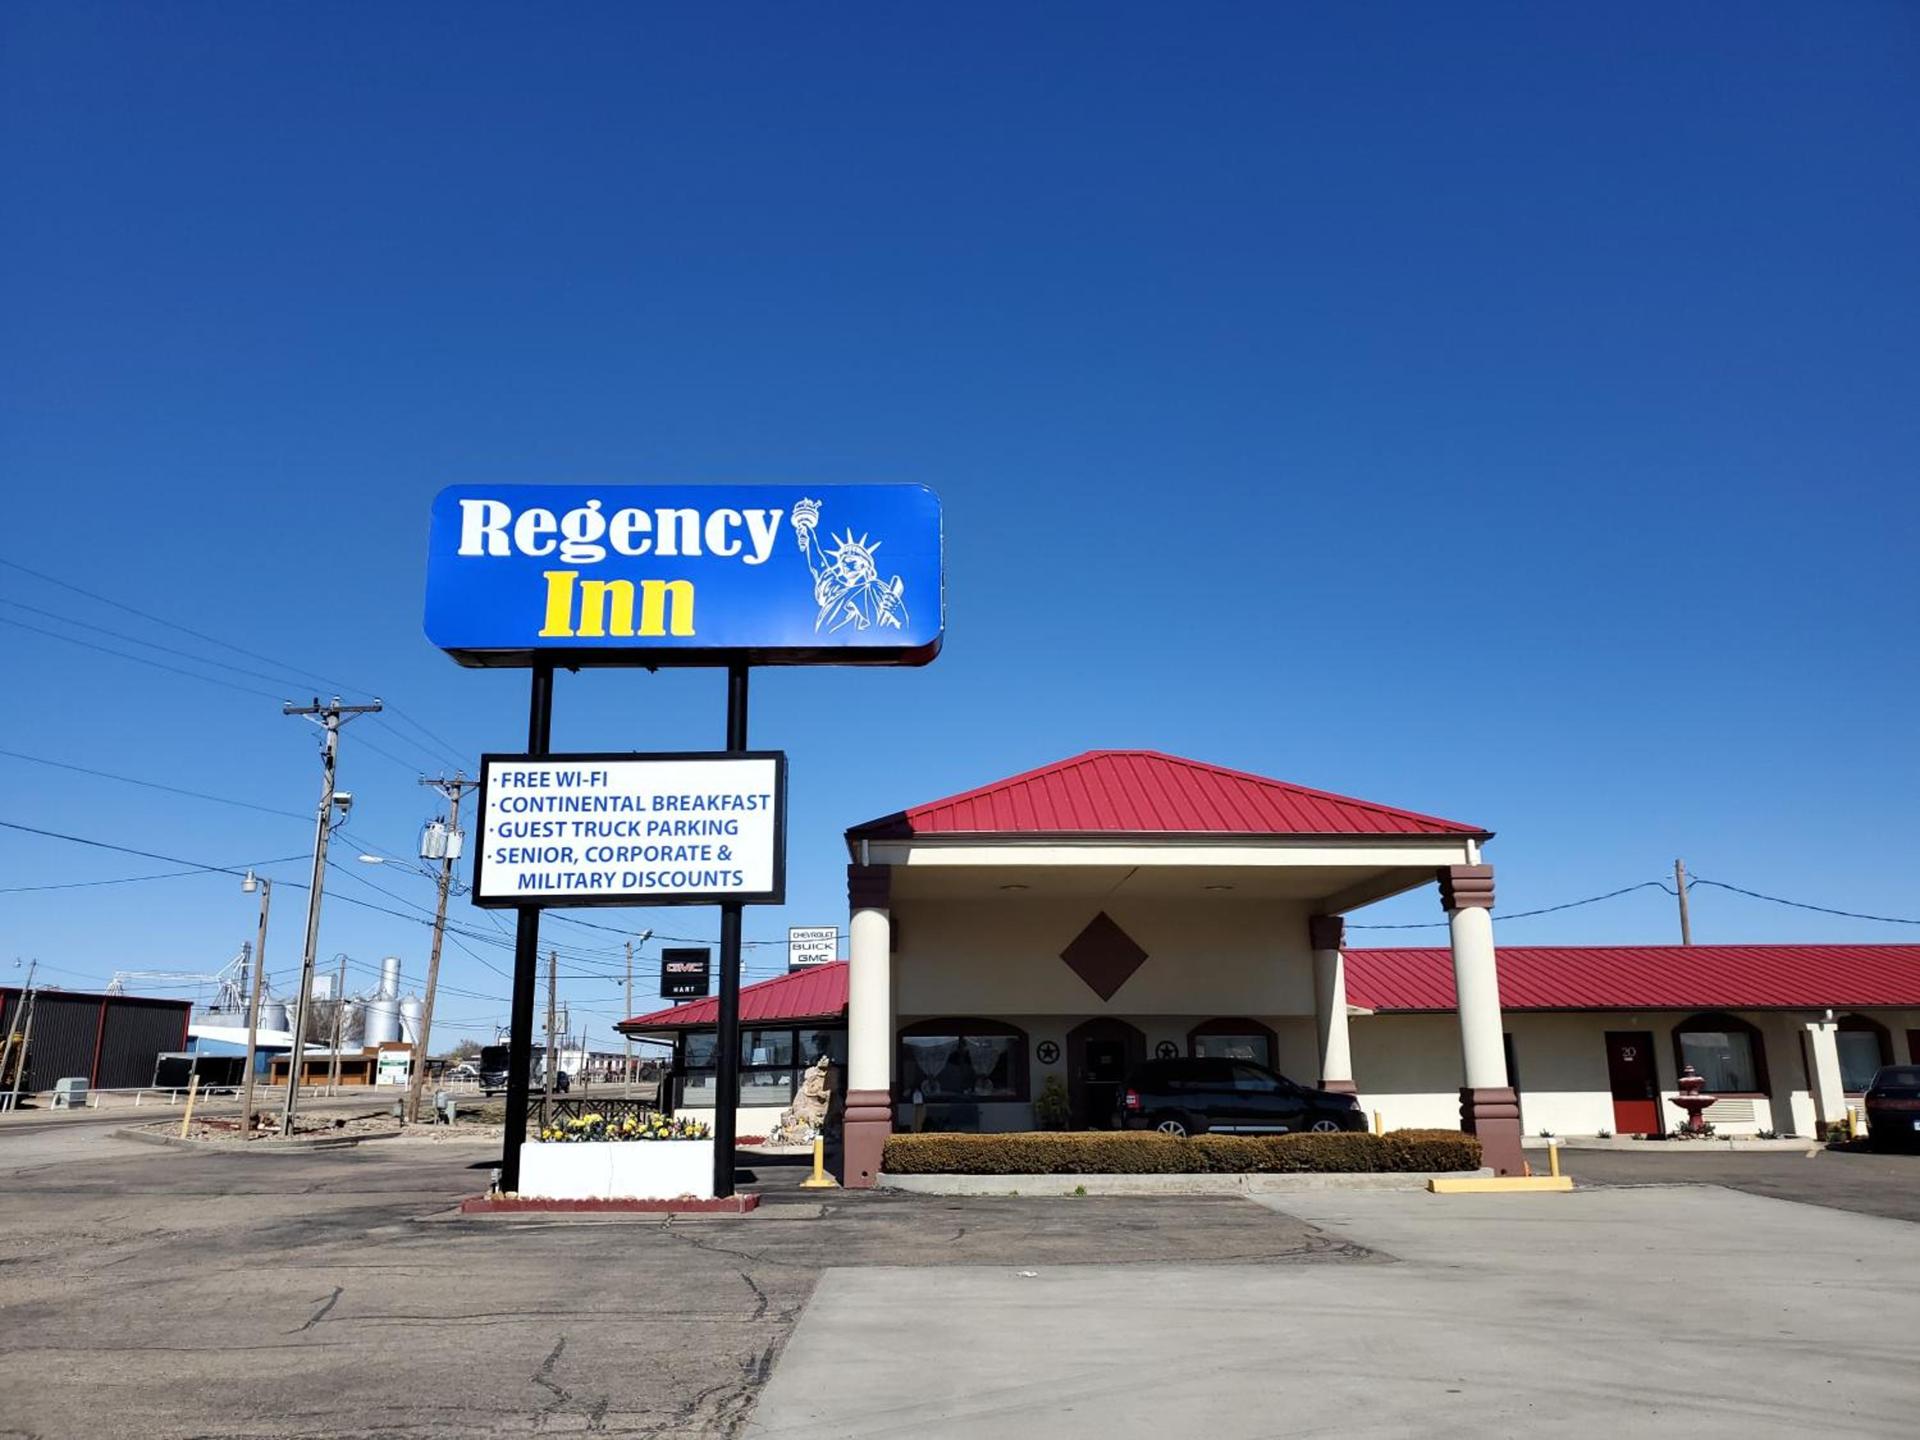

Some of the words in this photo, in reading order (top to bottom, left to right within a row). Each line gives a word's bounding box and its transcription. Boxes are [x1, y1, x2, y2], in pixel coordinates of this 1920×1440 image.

[458, 500, 783, 564] Regency
[539, 571, 695, 637] Inn
[502, 772, 550, 788] FREE
[556, 772, 607, 787] WI-FI
[500, 796, 646, 813] CONTINENTAL
[653, 795, 770, 811] BREAKFAST
[498, 822, 567, 838] GUEST
[572, 821, 640, 837] TRUCK
[647, 820, 737, 836] PARKING
[496, 847, 578, 864] SENIOR,
[585, 845, 711, 862] CORPORATE
[717, 845, 731, 860] &
[518, 872, 616, 889] MILITARY
[623, 870, 743, 888] DISCOUNTS
[792, 931, 834, 939] CHEVROLET
[666, 962, 704, 972] GMC
[798, 954, 829, 962] GMC
